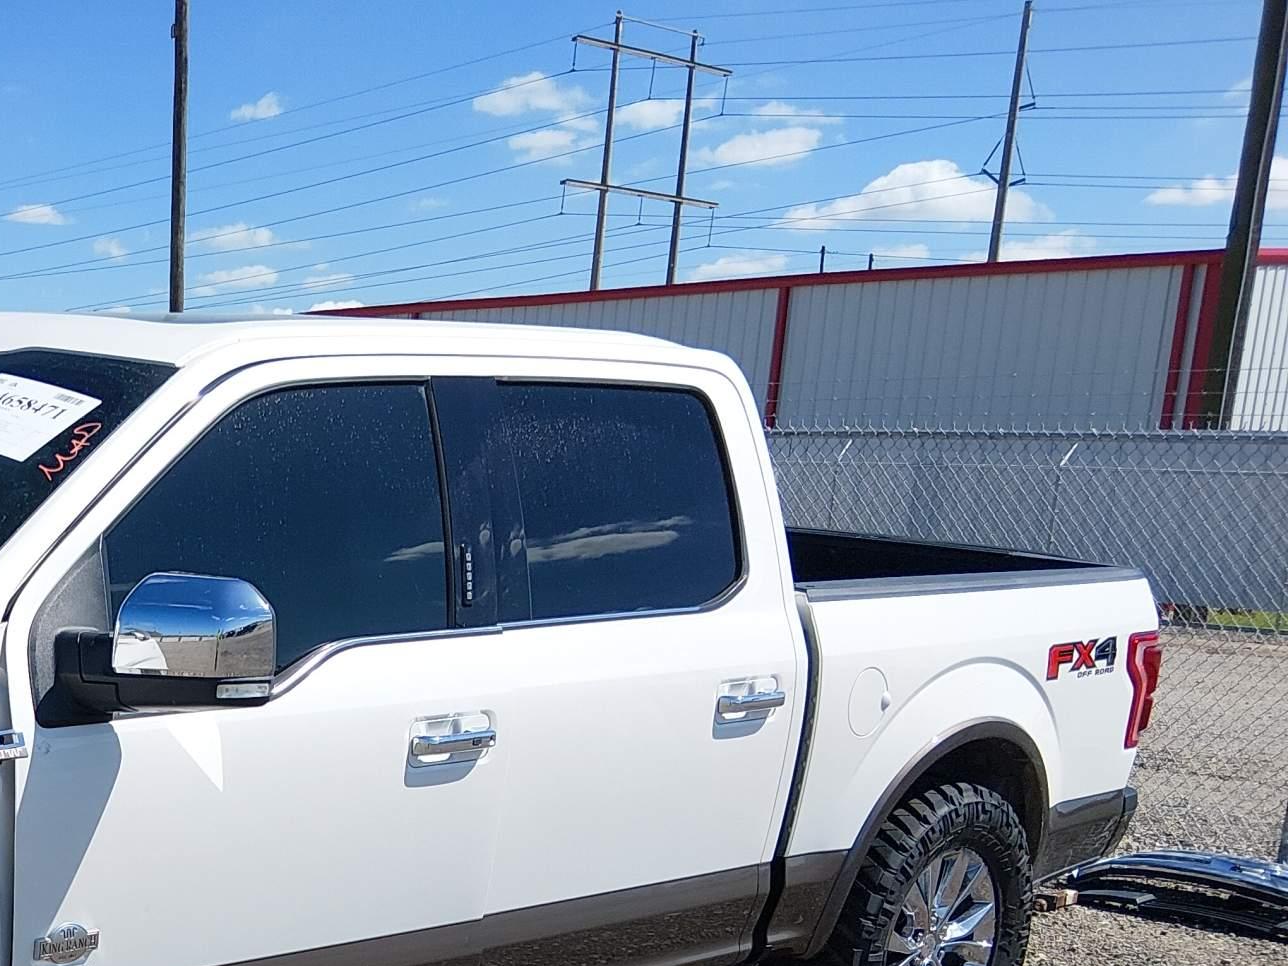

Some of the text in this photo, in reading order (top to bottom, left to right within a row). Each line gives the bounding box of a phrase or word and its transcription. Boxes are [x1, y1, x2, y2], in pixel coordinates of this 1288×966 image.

[1046, 636, 1118, 681] FX4
[1077, 666, 1115, 679] OFF ROAD
[40, 933, 98, 956] KING RANCH
